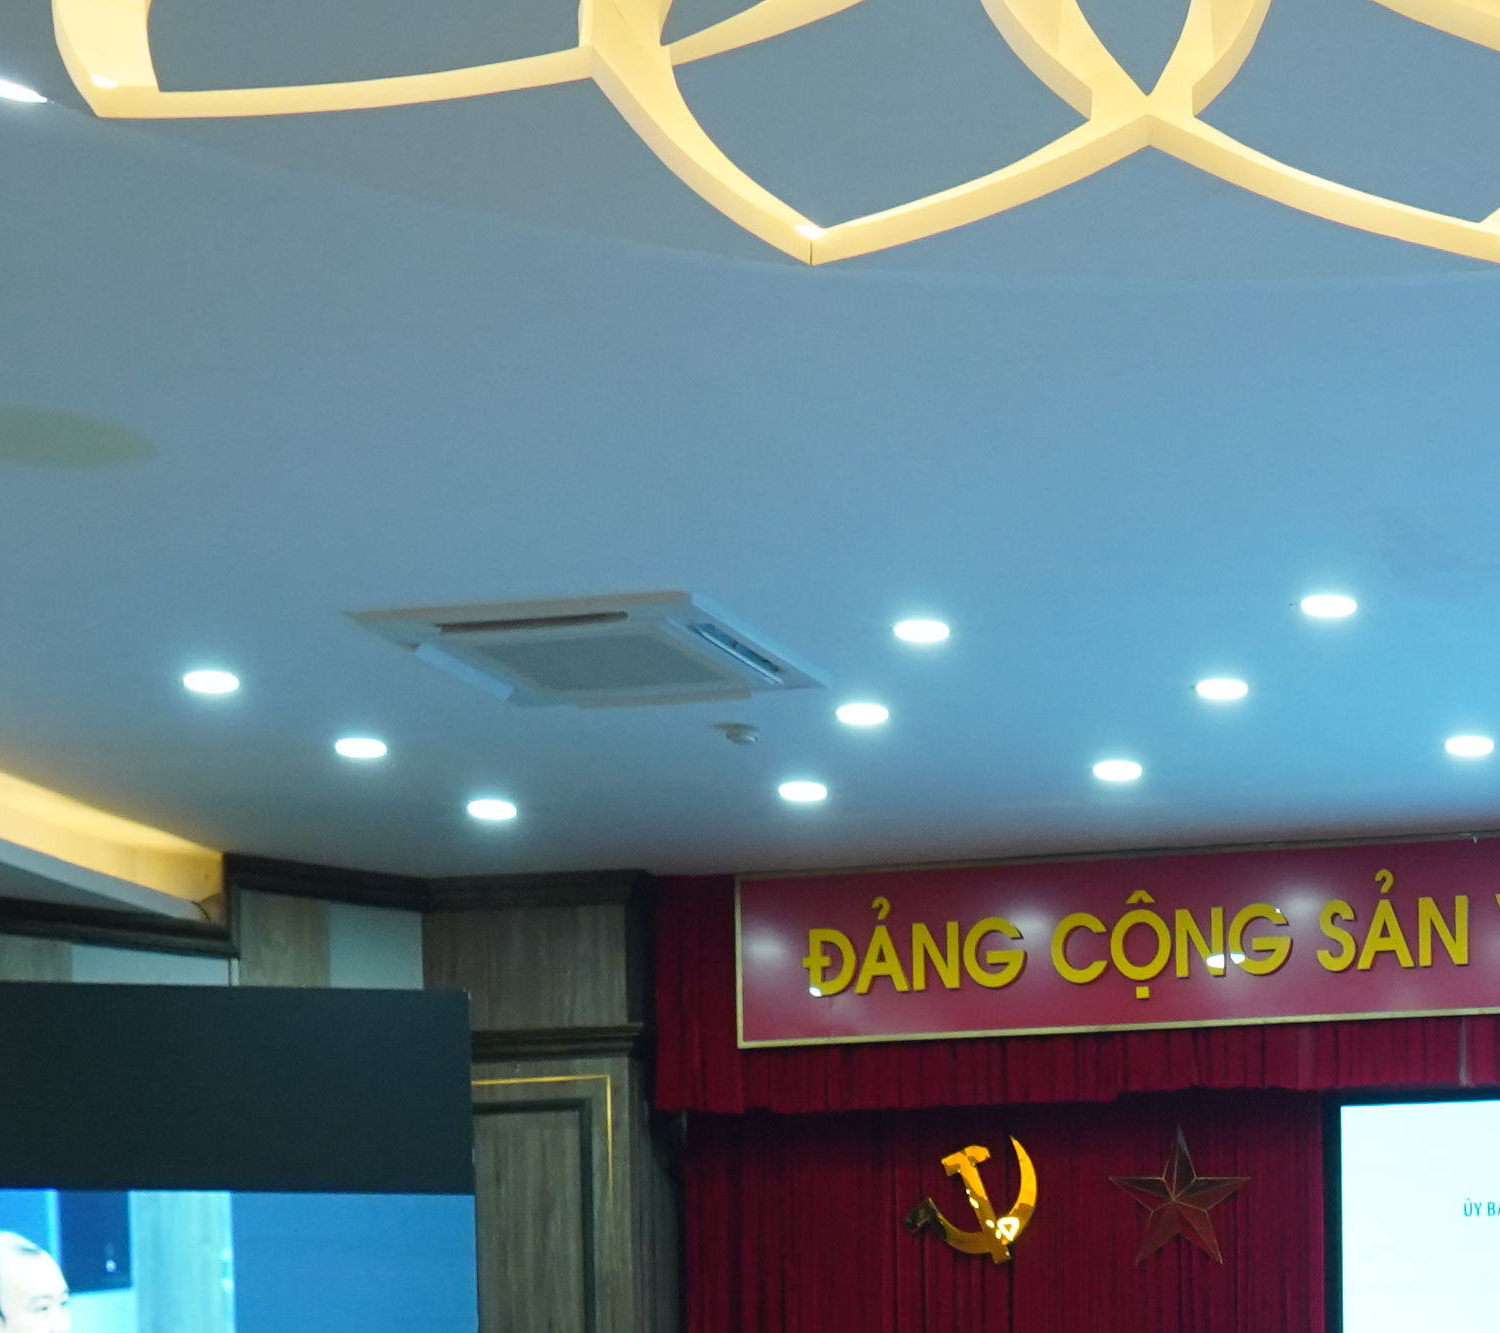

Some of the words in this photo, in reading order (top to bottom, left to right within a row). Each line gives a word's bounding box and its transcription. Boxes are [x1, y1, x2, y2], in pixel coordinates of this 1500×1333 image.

[803, 897, 1025, 997] ĐẢNG
[1051, 889, 1293, 1000] CỘNG
[1317, 869, 1470, 972] SẢN
